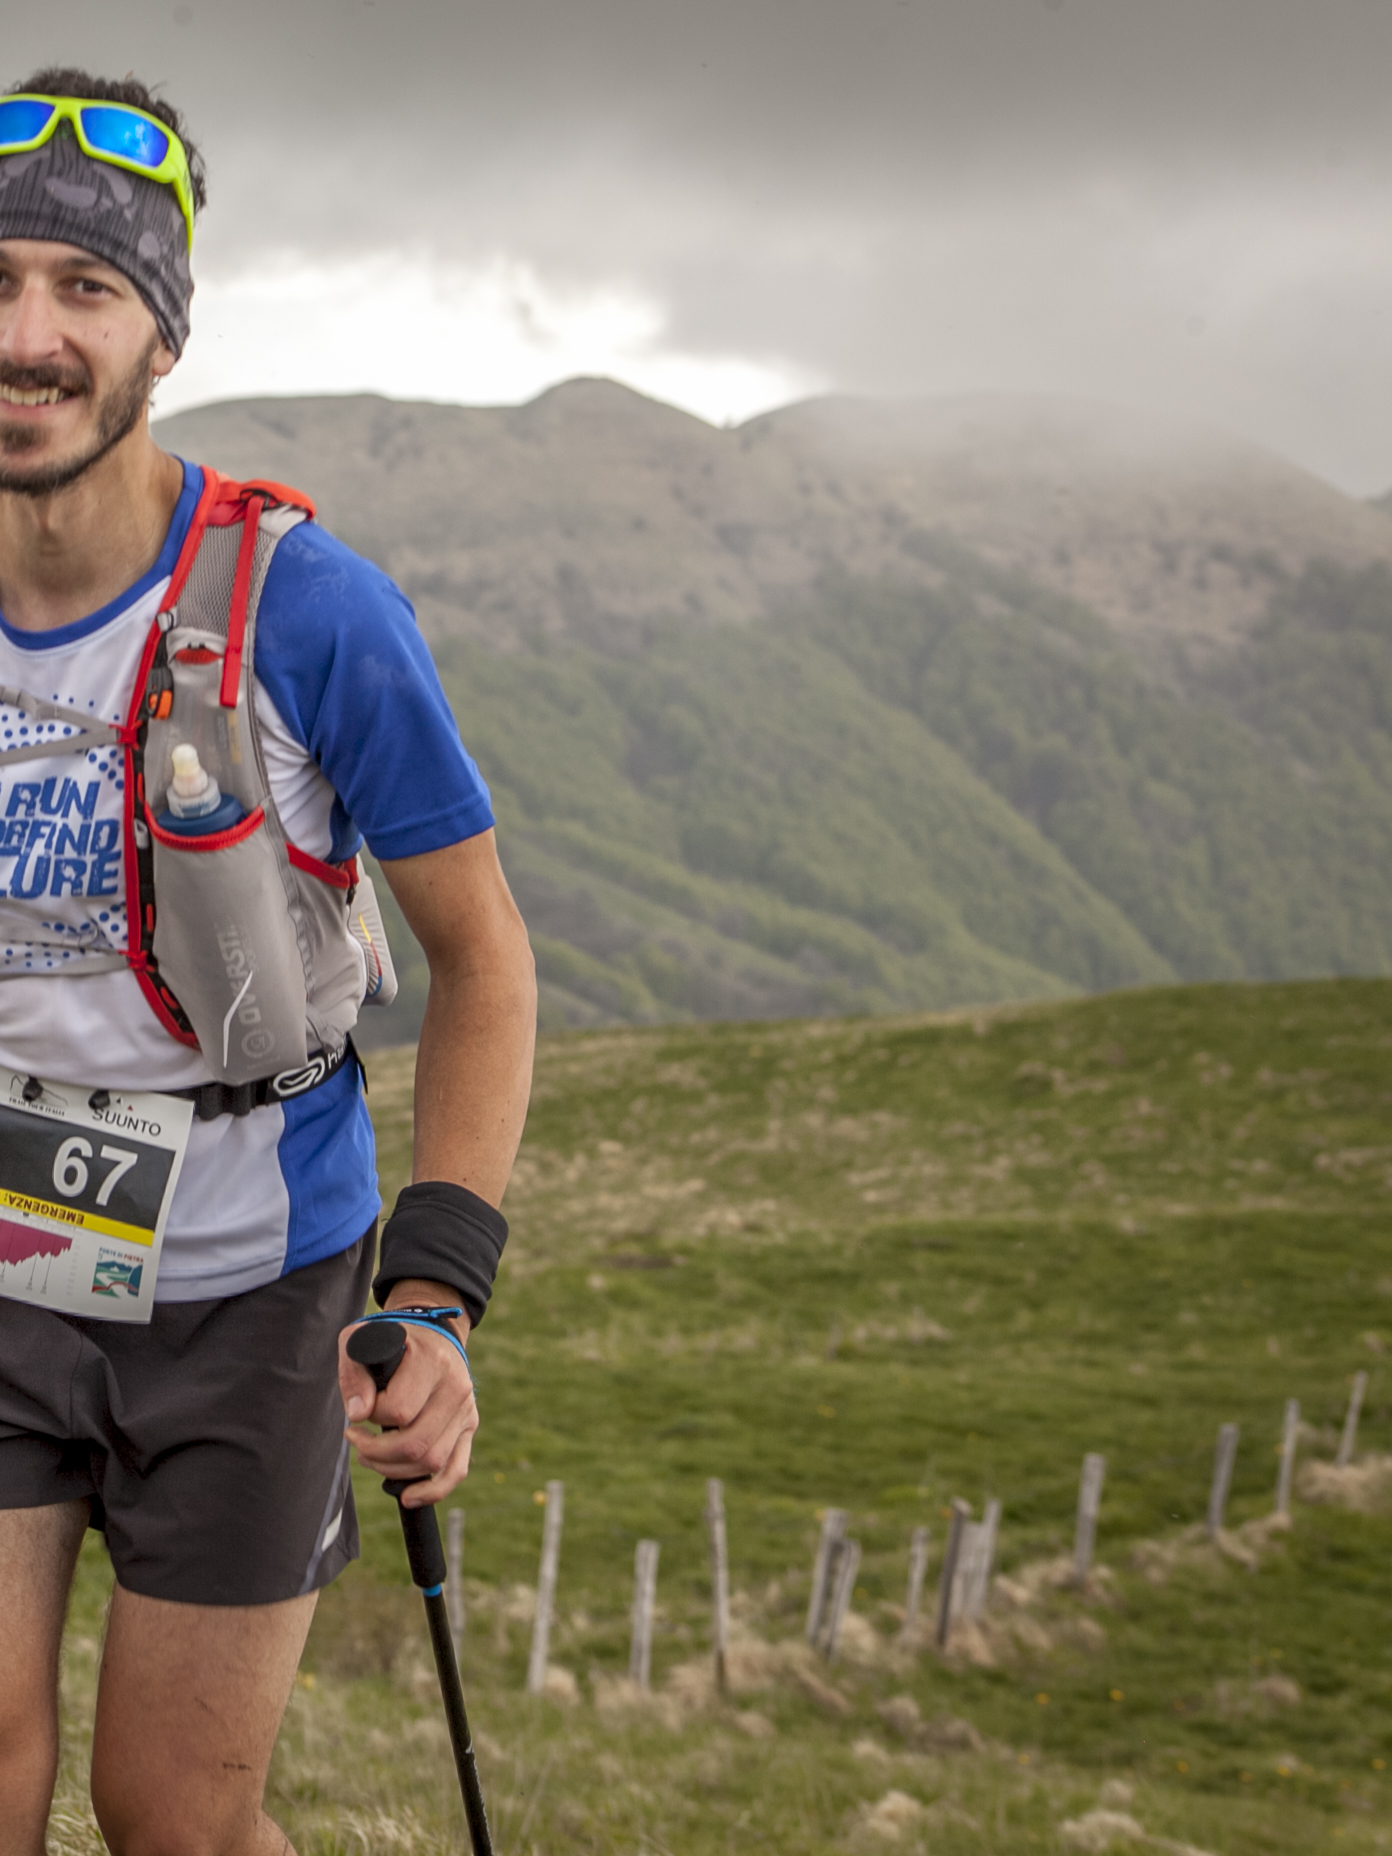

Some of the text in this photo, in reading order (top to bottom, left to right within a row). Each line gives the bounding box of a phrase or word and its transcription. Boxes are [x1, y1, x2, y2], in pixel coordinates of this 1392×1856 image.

[5, 776, 100, 820] RUN
[25, 817, 120, 857] FIND
[92, 1107, 162, 1137] SUUNTO
[52, 1136, 138, 1206] 67
[4, 1192, 84, 1225] EMERGENZA:
